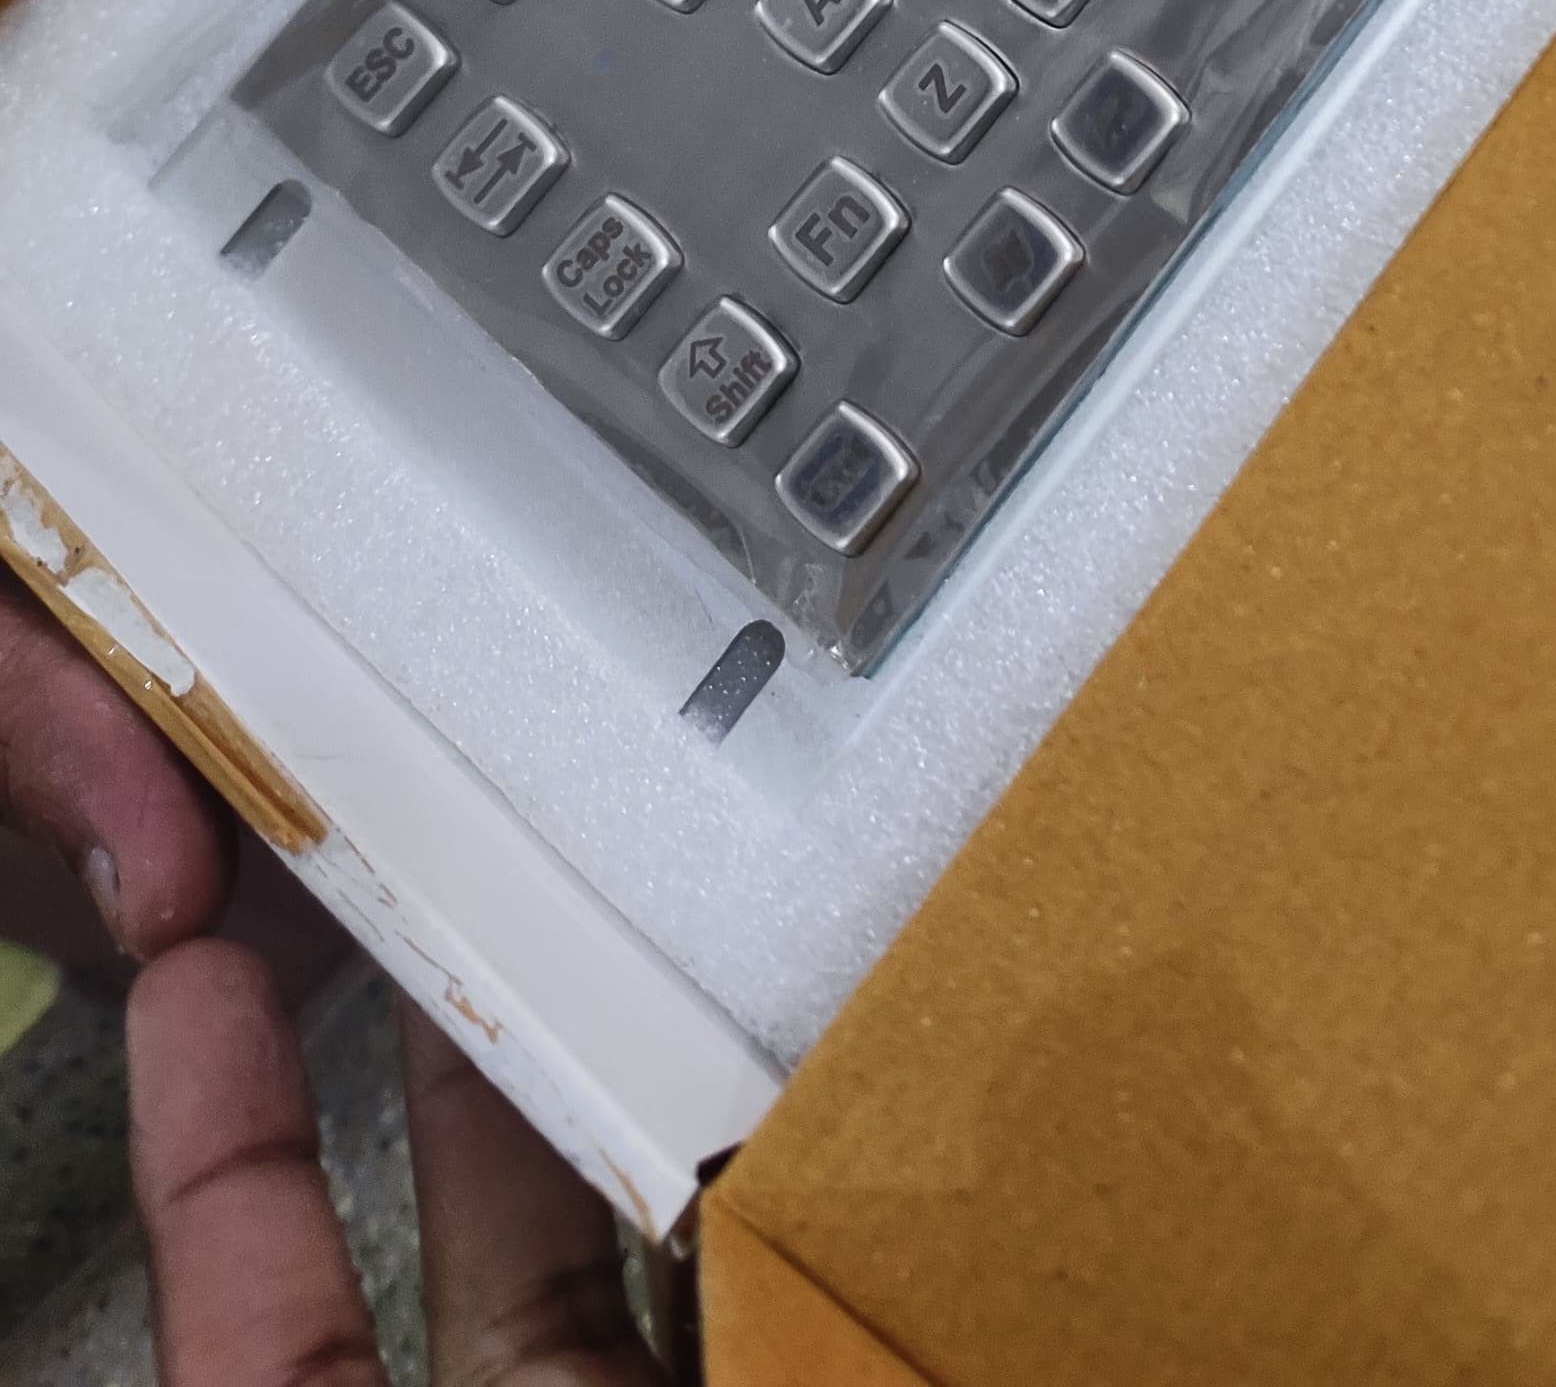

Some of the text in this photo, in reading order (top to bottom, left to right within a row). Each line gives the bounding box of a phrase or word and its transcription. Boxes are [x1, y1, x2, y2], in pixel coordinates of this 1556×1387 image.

[345, 27, 414, 102] ESC
[918, 64, 966, 114] Z
[556, 217, 624, 288] Caps
[794, 195, 871, 267] Fn
[583, 243, 650, 316] Lock
[705, 350, 773, 423] Shift
